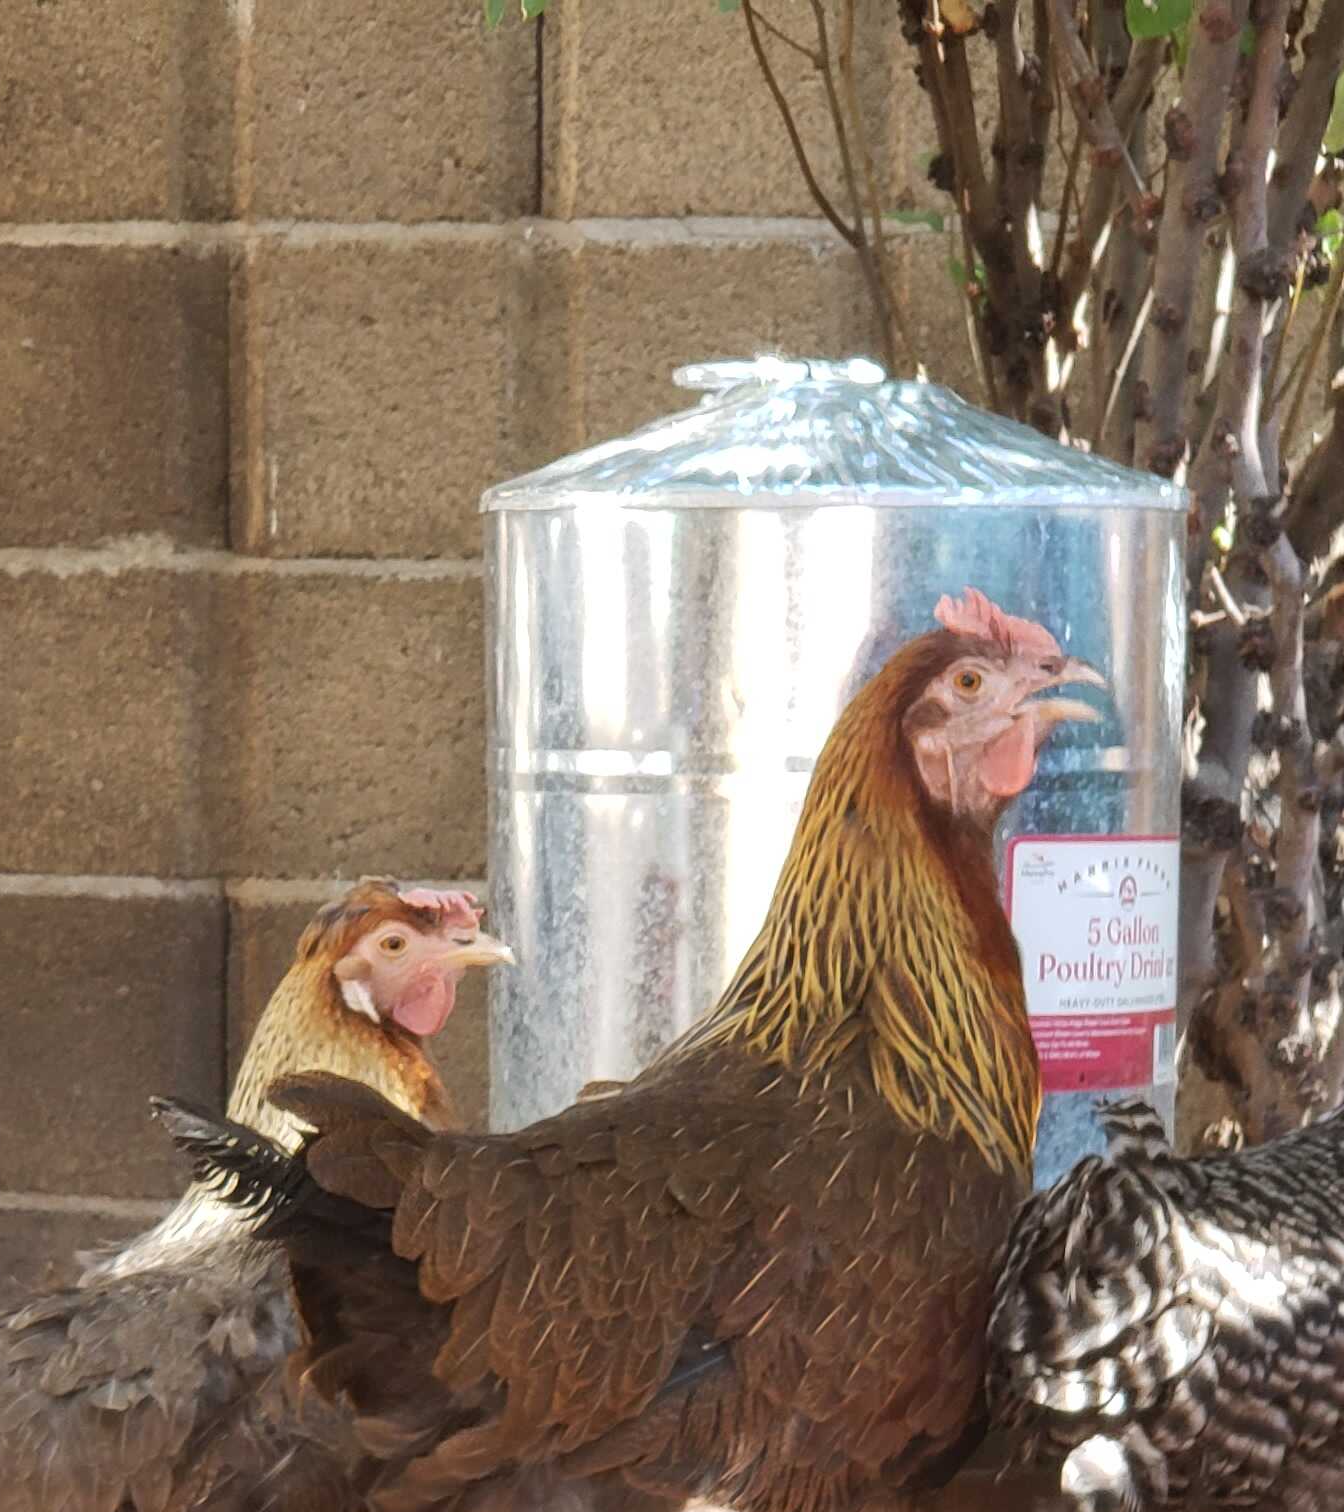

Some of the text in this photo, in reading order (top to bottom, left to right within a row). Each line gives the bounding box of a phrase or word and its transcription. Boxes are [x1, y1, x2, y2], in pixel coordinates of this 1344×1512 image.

[1088, 915, 1160, 947] 5 Gallon
[1038, 951, 1127, 989] Poultry
